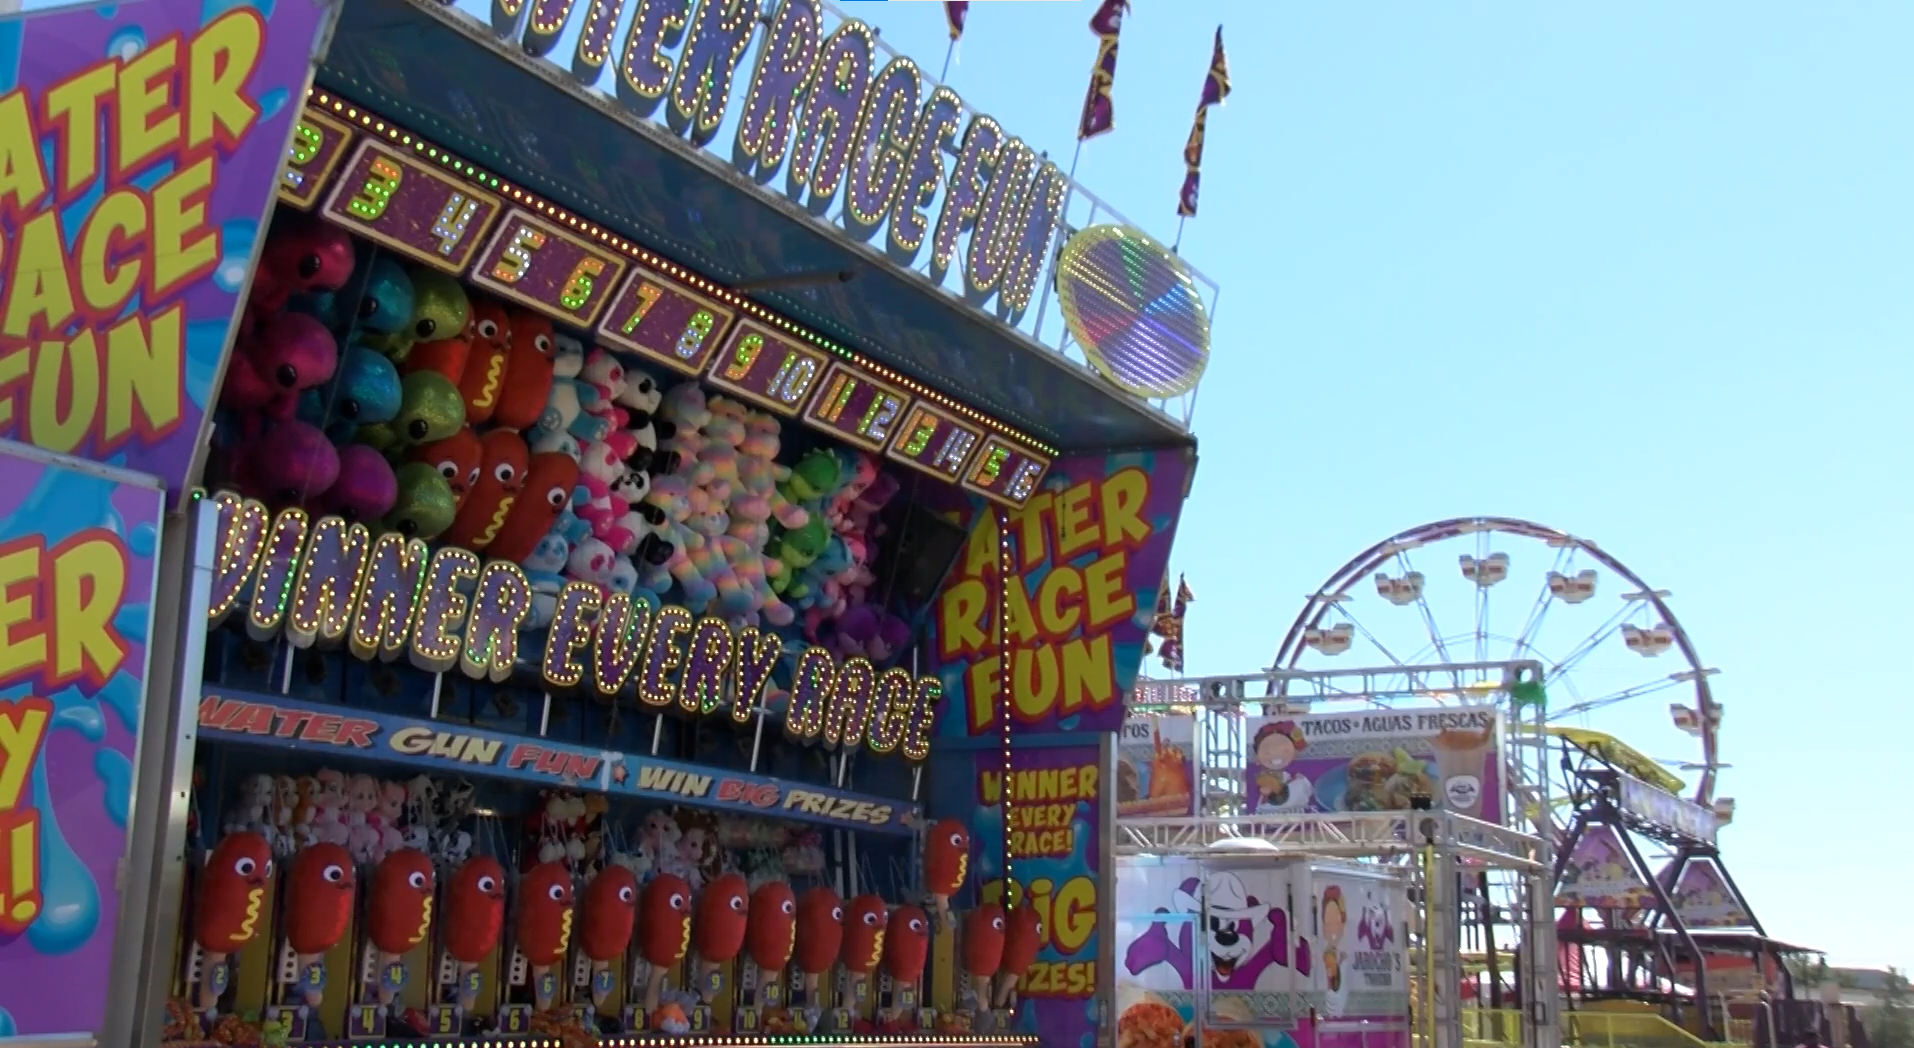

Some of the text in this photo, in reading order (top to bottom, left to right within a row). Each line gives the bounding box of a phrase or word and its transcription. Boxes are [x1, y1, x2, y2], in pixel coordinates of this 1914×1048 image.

[738, 0, 962, 252] RACE
[931, 113, 1069, 312] FUN
[345, 158, 479, 256] 3 4
[0, 156, 218, 338] ACE
[491, 224, 606, 310] 5 6
[620, 282, 715, 360] 7 8
[724, 333, 816, 402] 9 10
[817, 373, 899, 442] 11 12
[896, 409, 977, 474] 13 14
[1003, 458, 1042, 500] 16
[945, 468, 1150, 577] ATER
[943, 551, 1132, 653] RACE
[542, 580, 783, 723] EVERY
[785, 646, 942, 760] RACE
[971, 634, 1112, 730] FUN
[1301, 711, 1488, 736] TACOS AGUAS FRESCAS
[200, 695, 894, 826] WATER GUN FUN WIN BIG PRIZES
[1009, 803, 1076, 828] EVERY
[1010, 828, 1073, 854] RACE!
[215, 967, 225, 984] 2
[310, 967, 321, 985] 3
[390, 967, 403, 985] 4
[469, 973, 480, 990] 5
[543, 977, 551, 993] 6
[600, 970, 610, 988] 7
[710, 973, 721, 990] 9
[766, 983, 780, 996] 10
[362, 1007, 375, 1033] 4
[439, 1008, 451, 1032] 5
[509, 1008, 521, 1031] 6
[693, 1007, 703, 1030] 9
[743, 1009, 755, 1029] 10
